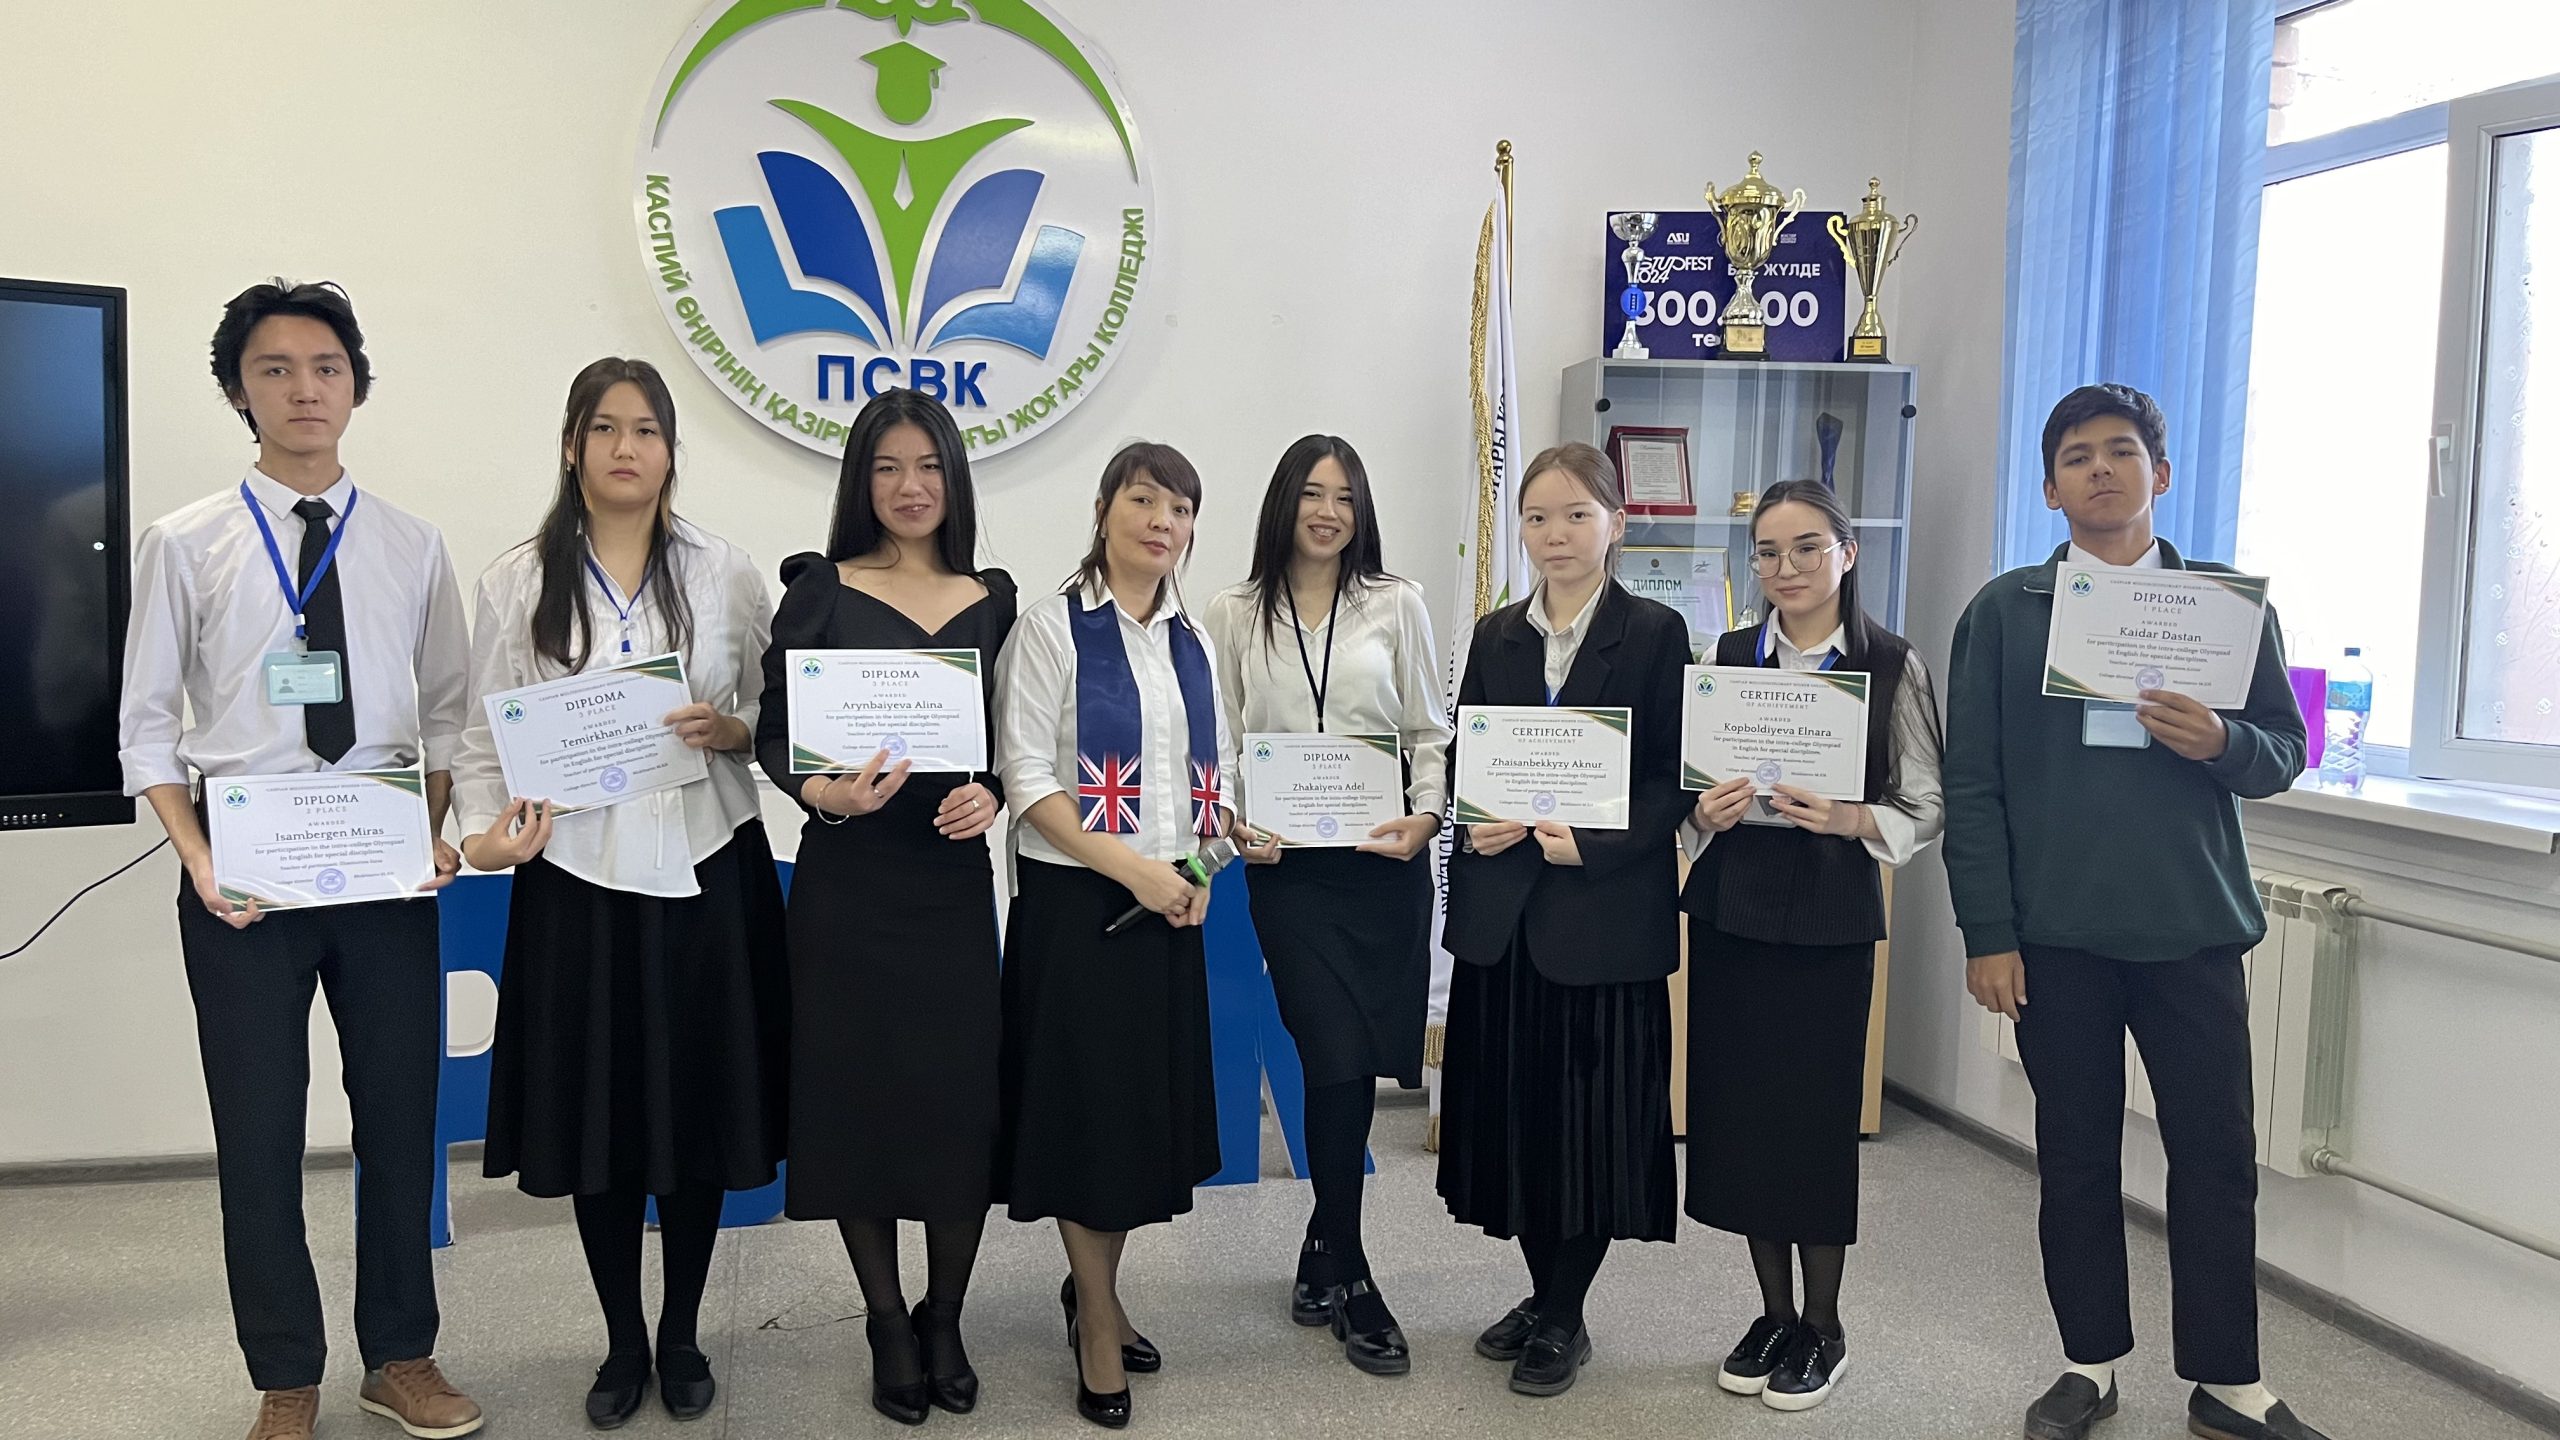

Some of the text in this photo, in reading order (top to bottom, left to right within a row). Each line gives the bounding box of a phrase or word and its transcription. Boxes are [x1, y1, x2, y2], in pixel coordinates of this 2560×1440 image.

[1638, 269, 1670, 283] 024
[1763, 263, 1821, 278] ЖҮЛДЕ
[646, 174, 1147, 447] КАСПИЙ ӨҢІРІНІҢ ҚАЗІРГ ЖОҒАРЫ КОЛЛЕДЖІ
[1635, 290, 1819, 327] 300.00
[818, 354, 987, 407] ПСВК
[1632, 578, 1683, 593] ДИПЛОМ
[2133, 592, 2197, 606] DIPLOMA
[2120, 627, 2201, 642] Kaidar Dastan
[862, 670, 920, 679] DIPLOMA
[565, 690, 626, 711] DIPLOMA
[1740, 690, 1817, 702] CERTIFICATE
[842, 700, 943, 711] Arynbaiyeva Alina
[560, 723, 648, 748] Temirkhan Arai
[1512, 727, 1583, 737] CERTIFICATE
[1724, 723, 1831, 737] Kopboldiyeva Elnara
[1304, 753, 1351, 761] DIPLOMA
[1492, 757, 1602, 769] Zhaisanbekkyzy Aknur
[1293, 782, 1365, 792] Zhakaiyeva Adel
[294, 794, 359, 806] DIPLOMA
[275, 827, 384, 841] Isambergen Miras
